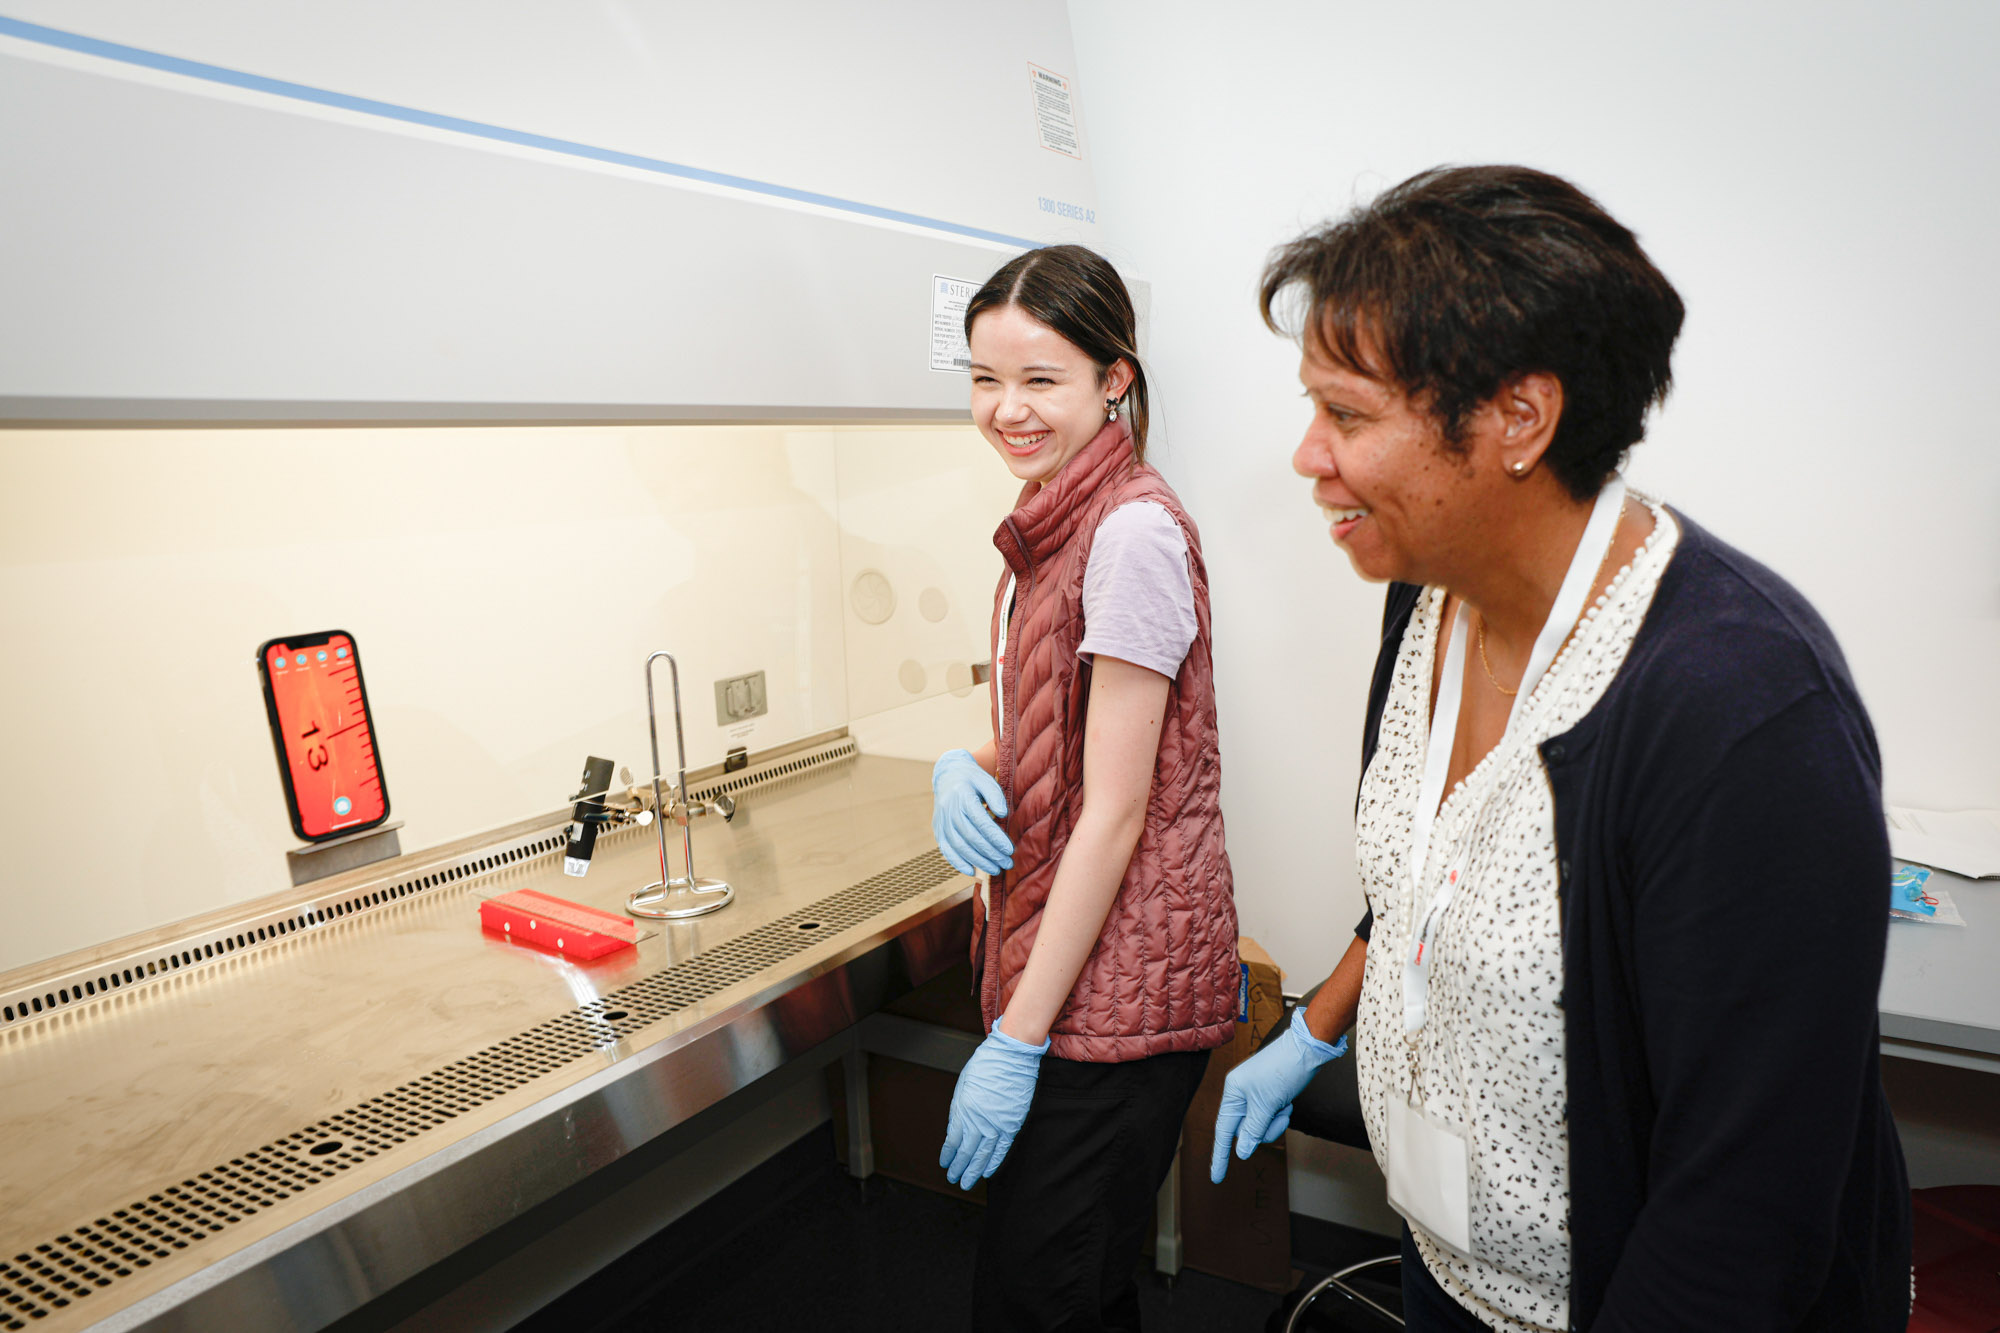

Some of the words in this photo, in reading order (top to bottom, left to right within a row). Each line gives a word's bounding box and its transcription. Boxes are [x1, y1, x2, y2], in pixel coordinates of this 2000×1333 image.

[1038, 72, 1062, 87] WARNING
[1038, 195, 1056, 214] 1300
[1057, 199, 1084, 222] SERIES
[1085, 208, 1096, 225] A2
[302, 719, 329, 772] 13
[1249, 983, 1264, 1050] GLA
